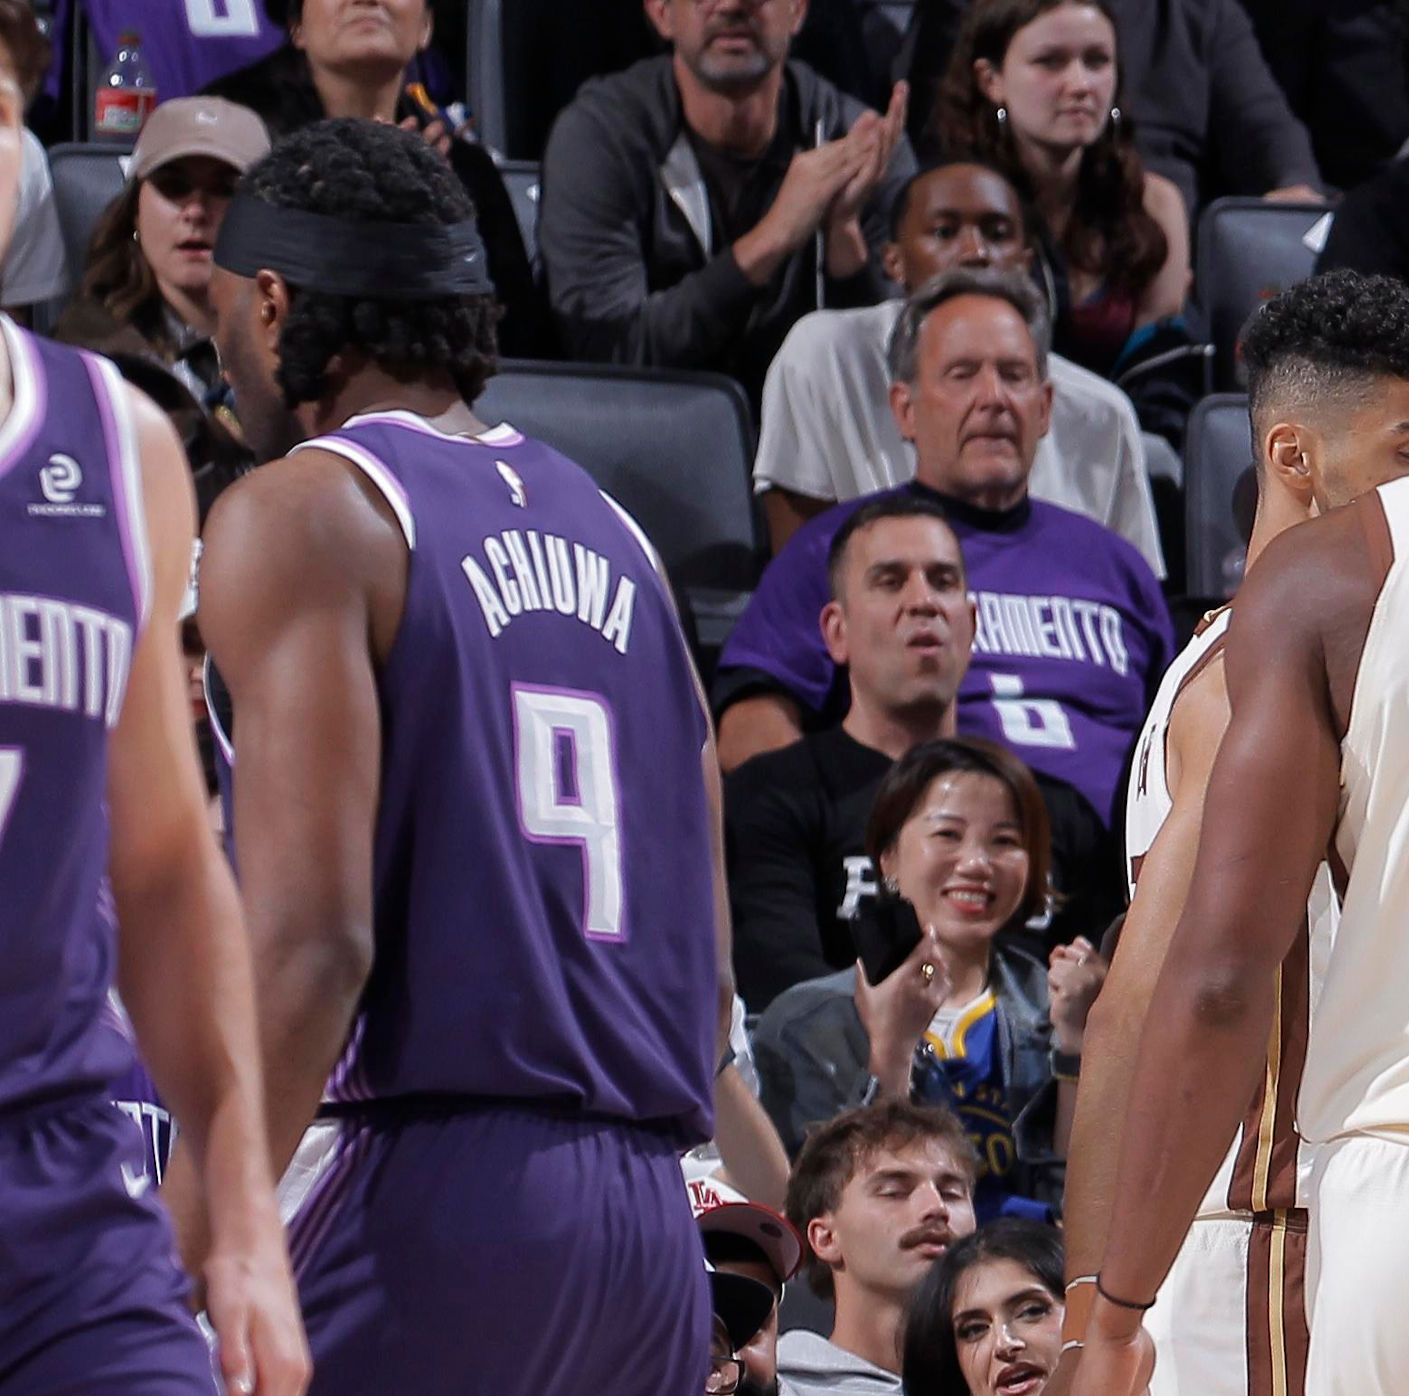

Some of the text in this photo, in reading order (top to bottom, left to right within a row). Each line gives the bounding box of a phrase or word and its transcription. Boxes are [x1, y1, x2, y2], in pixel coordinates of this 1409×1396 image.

[461, 529, 636, 655] ACHIUWA
[0, 594, 132, 729] ENTO
[990, 673, 1076, 750] 6
[511, 681, 627, 942] 9
[688, 1180, 724, 1212] LA
